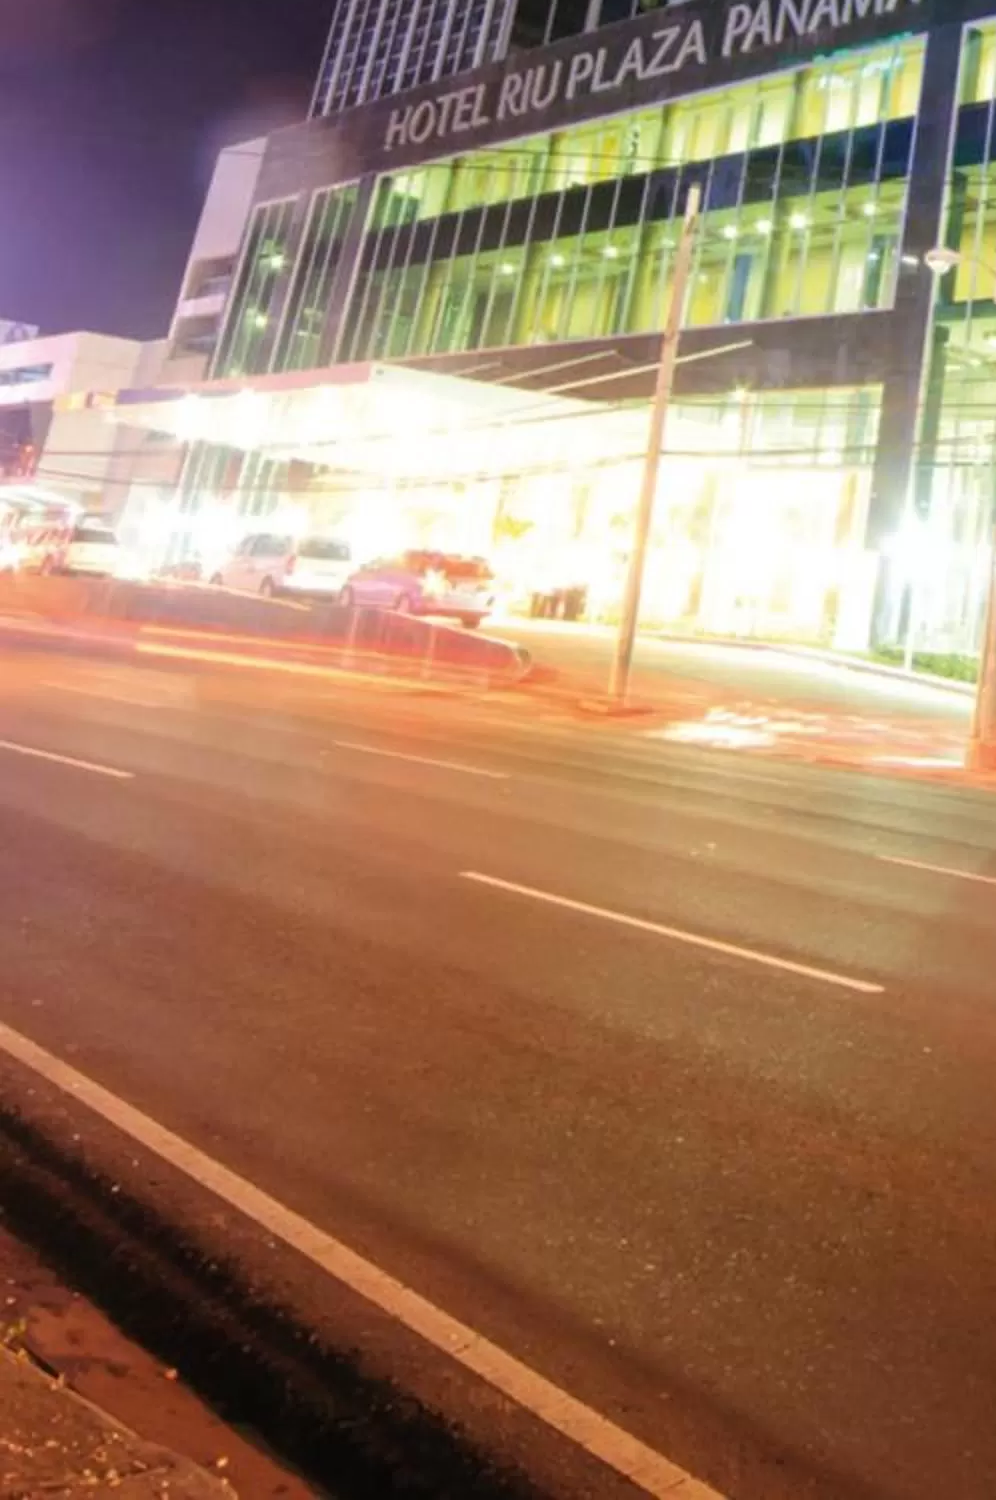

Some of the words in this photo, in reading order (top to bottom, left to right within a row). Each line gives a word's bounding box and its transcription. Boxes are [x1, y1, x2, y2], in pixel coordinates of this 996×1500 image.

[383, 92, 489, 153] HOTEL
[493, 55, 562, 119] RIU
[563, 19, 708, 99] PLAZA
